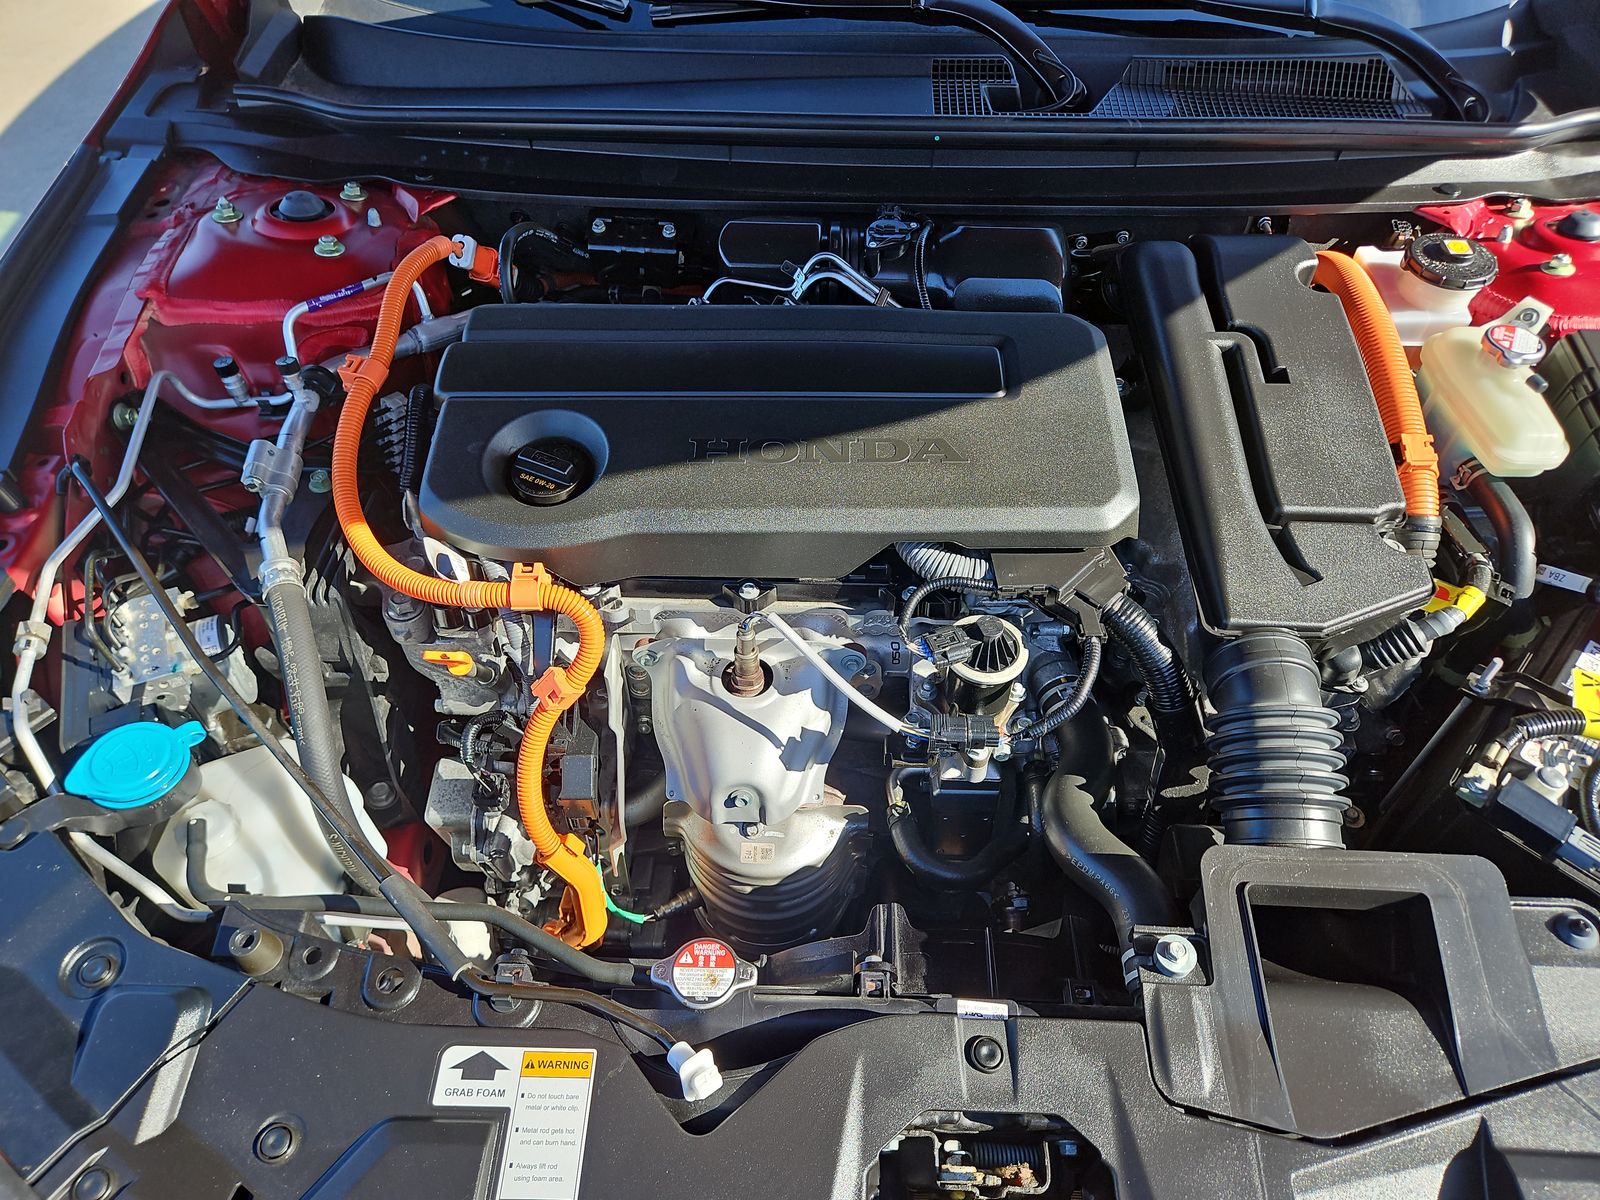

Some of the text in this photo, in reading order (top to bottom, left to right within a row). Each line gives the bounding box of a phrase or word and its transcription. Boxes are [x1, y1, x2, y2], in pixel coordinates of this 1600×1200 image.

[687, 437, 971, 464] HONDA
[519, 472, 535, 483] SAE
[534, 477, 556, 490] 0W-20
[694, 949, 726, 957] WARNUNG
[537, 1060, 589, 1070] WARNING
[444, 1088, 506, 1098] GRAB FOAM
[567, 1104, 580, 1112] clip.
[514, 1175, 530, 1183] using
